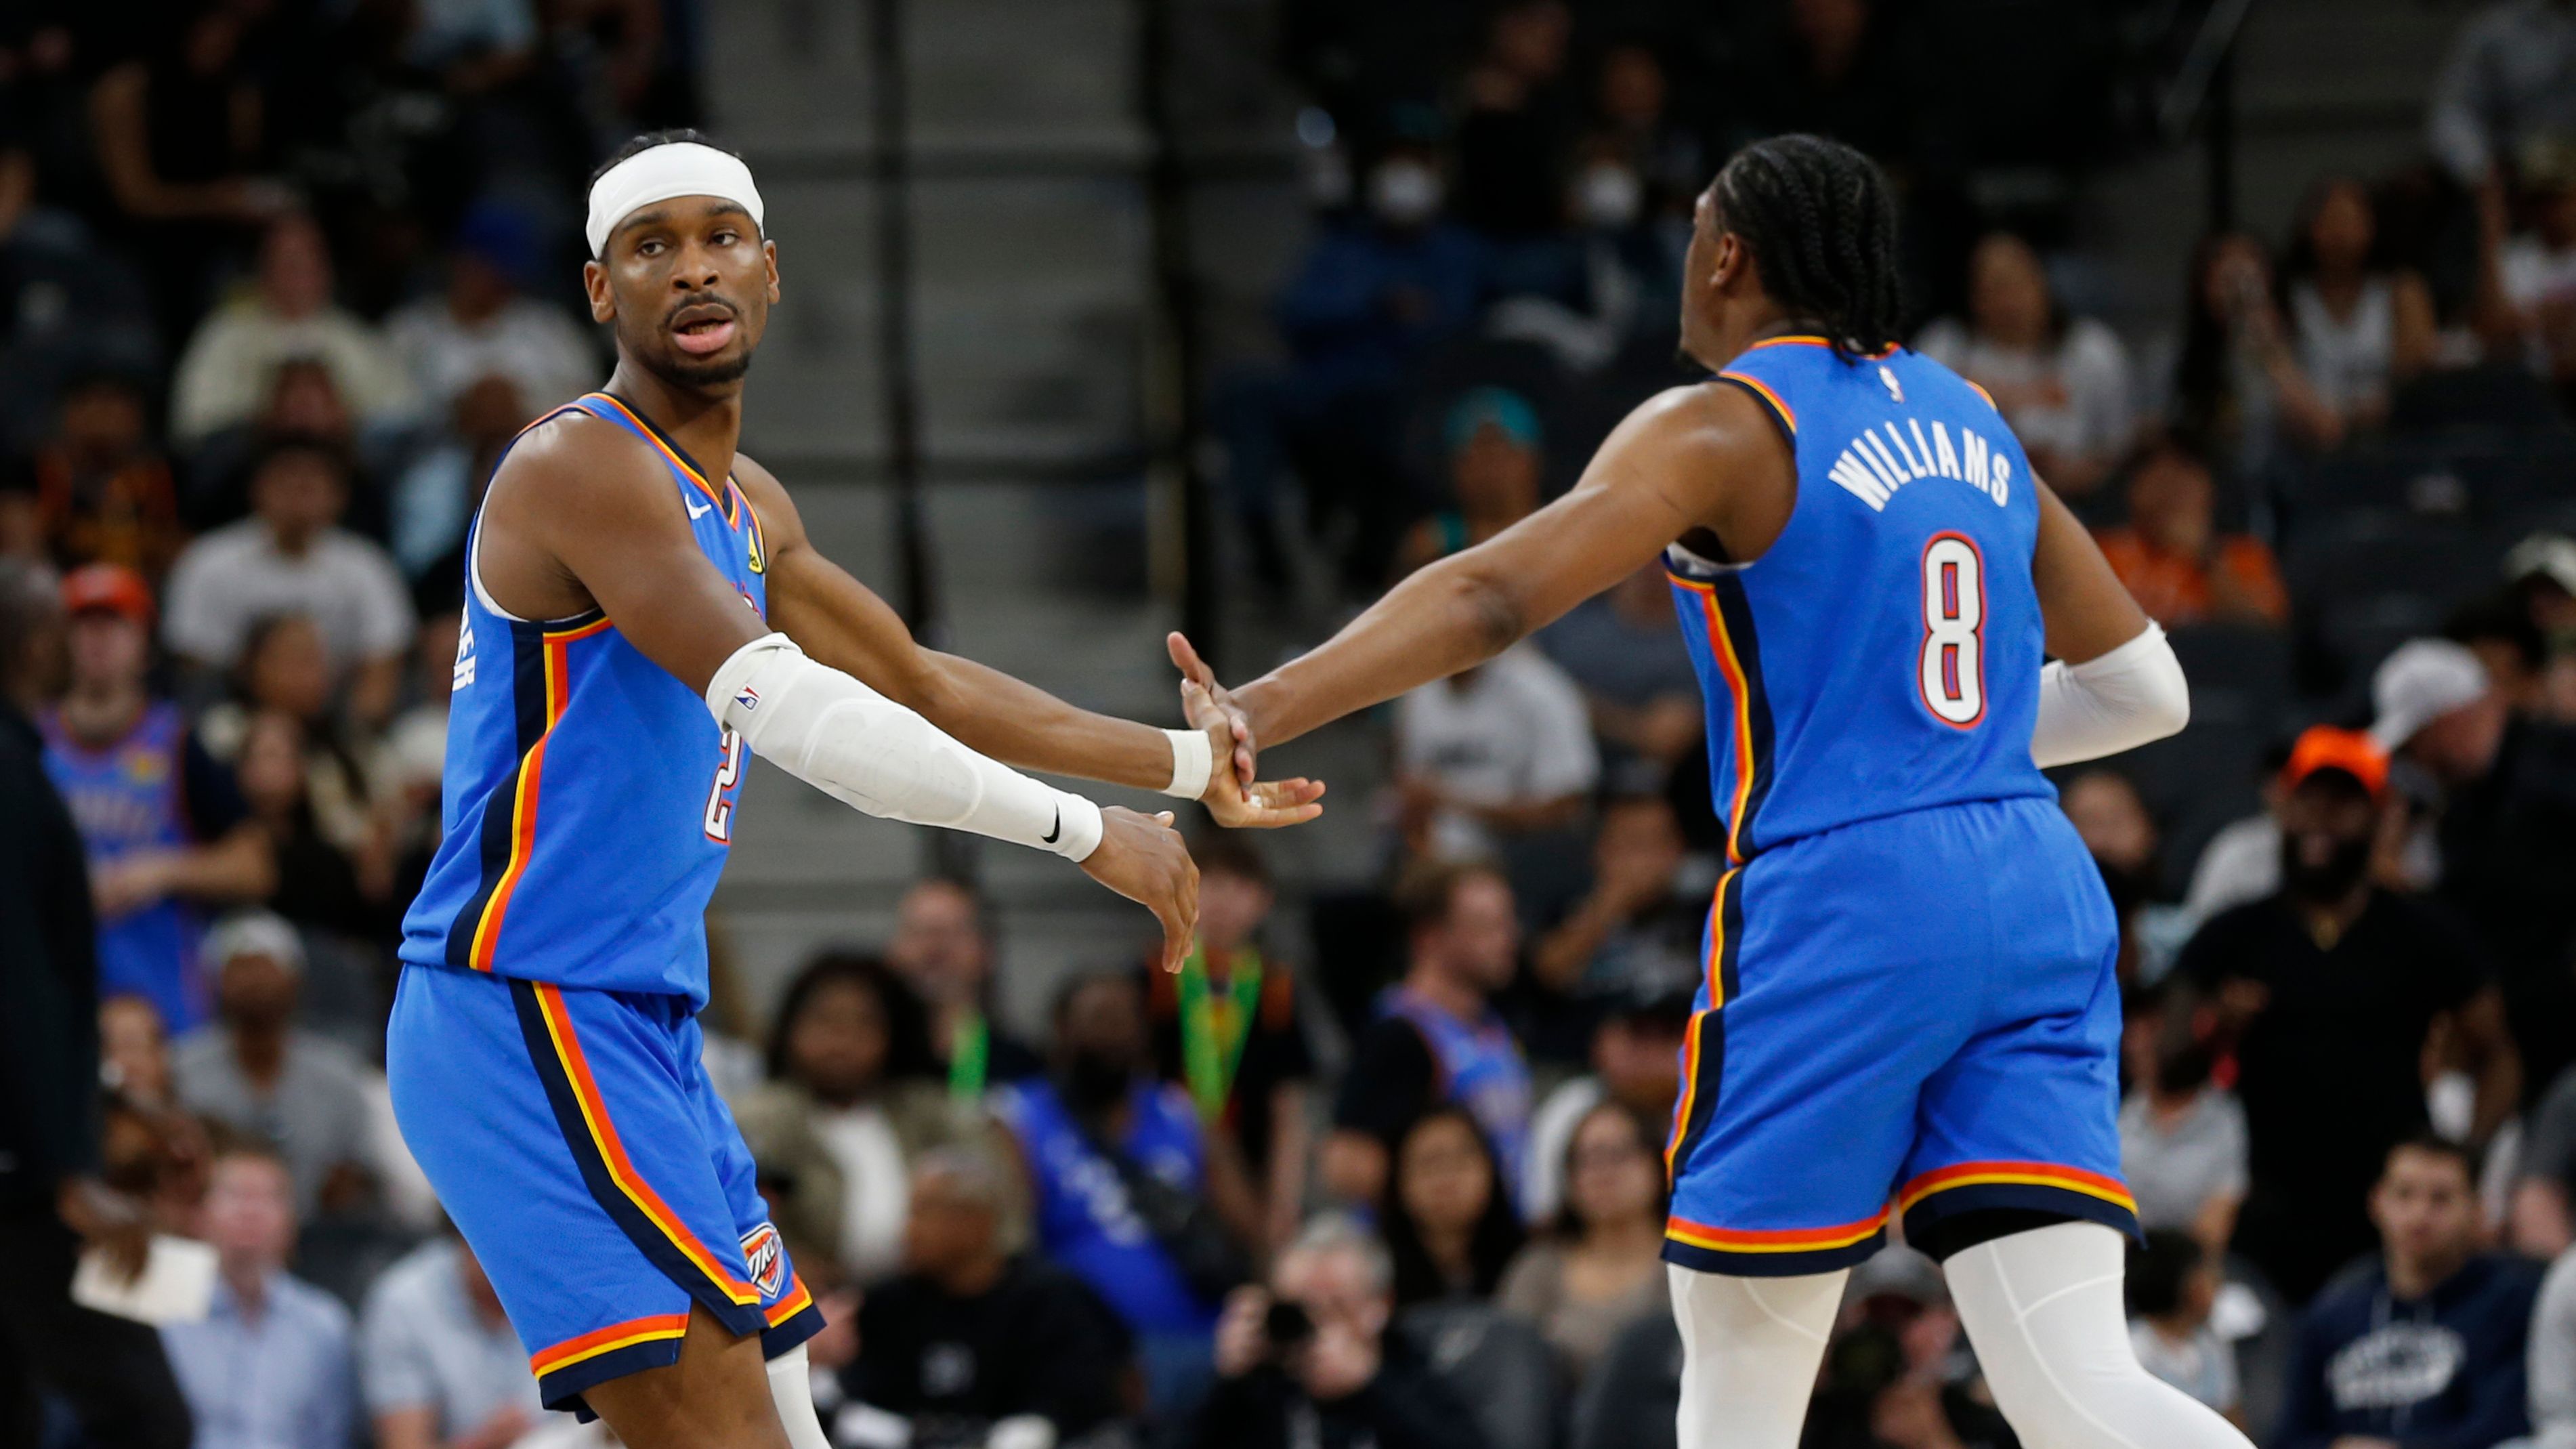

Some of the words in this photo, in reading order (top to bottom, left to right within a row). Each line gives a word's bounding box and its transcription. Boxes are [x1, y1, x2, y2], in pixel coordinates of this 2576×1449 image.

[1828, 417, 2011, 513] WILLIAMS
[1918, 530, 1987, 730] 8
[704, 729, 743, 845] 2
